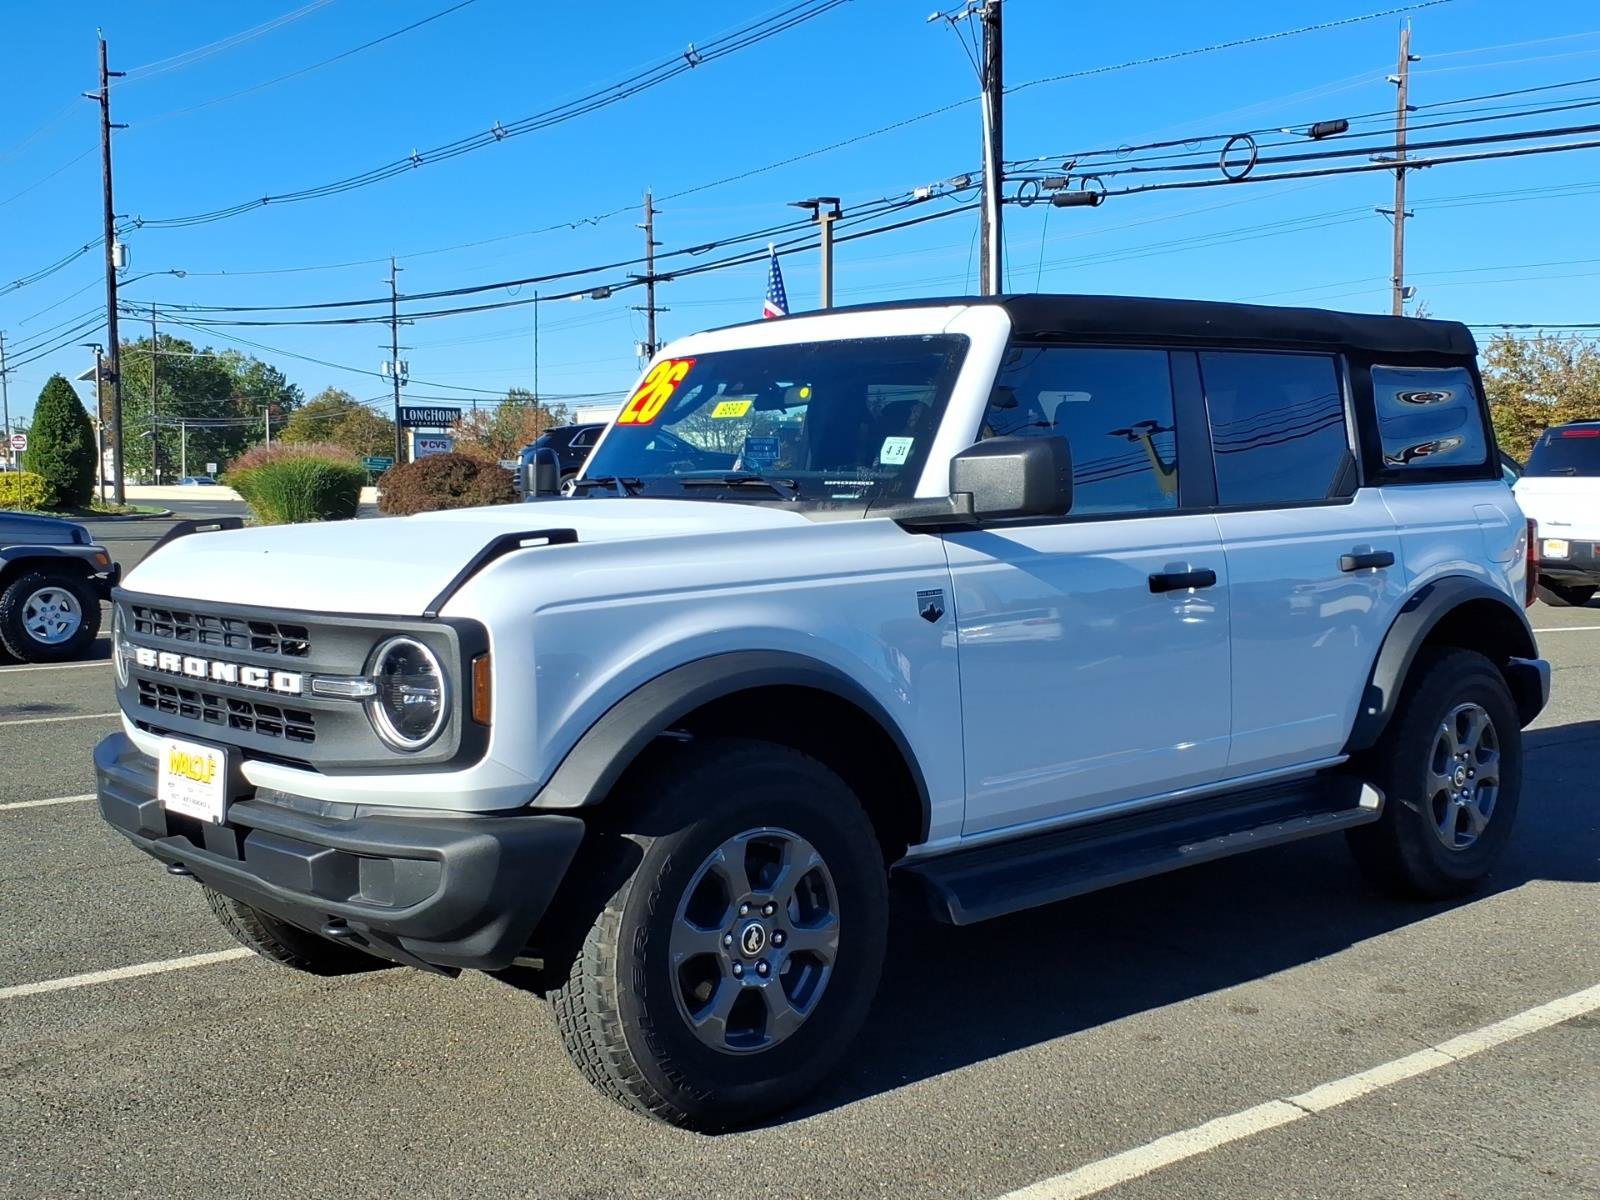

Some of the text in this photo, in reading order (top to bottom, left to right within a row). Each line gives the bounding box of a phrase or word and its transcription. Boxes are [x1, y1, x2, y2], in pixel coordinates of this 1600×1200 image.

[617, 359, 690, 424] 26
[402, 408, 459, 422] LONGHORN
[428, 440, 447, 449] CVS
[135, 648, 304, 694] BRONCO
